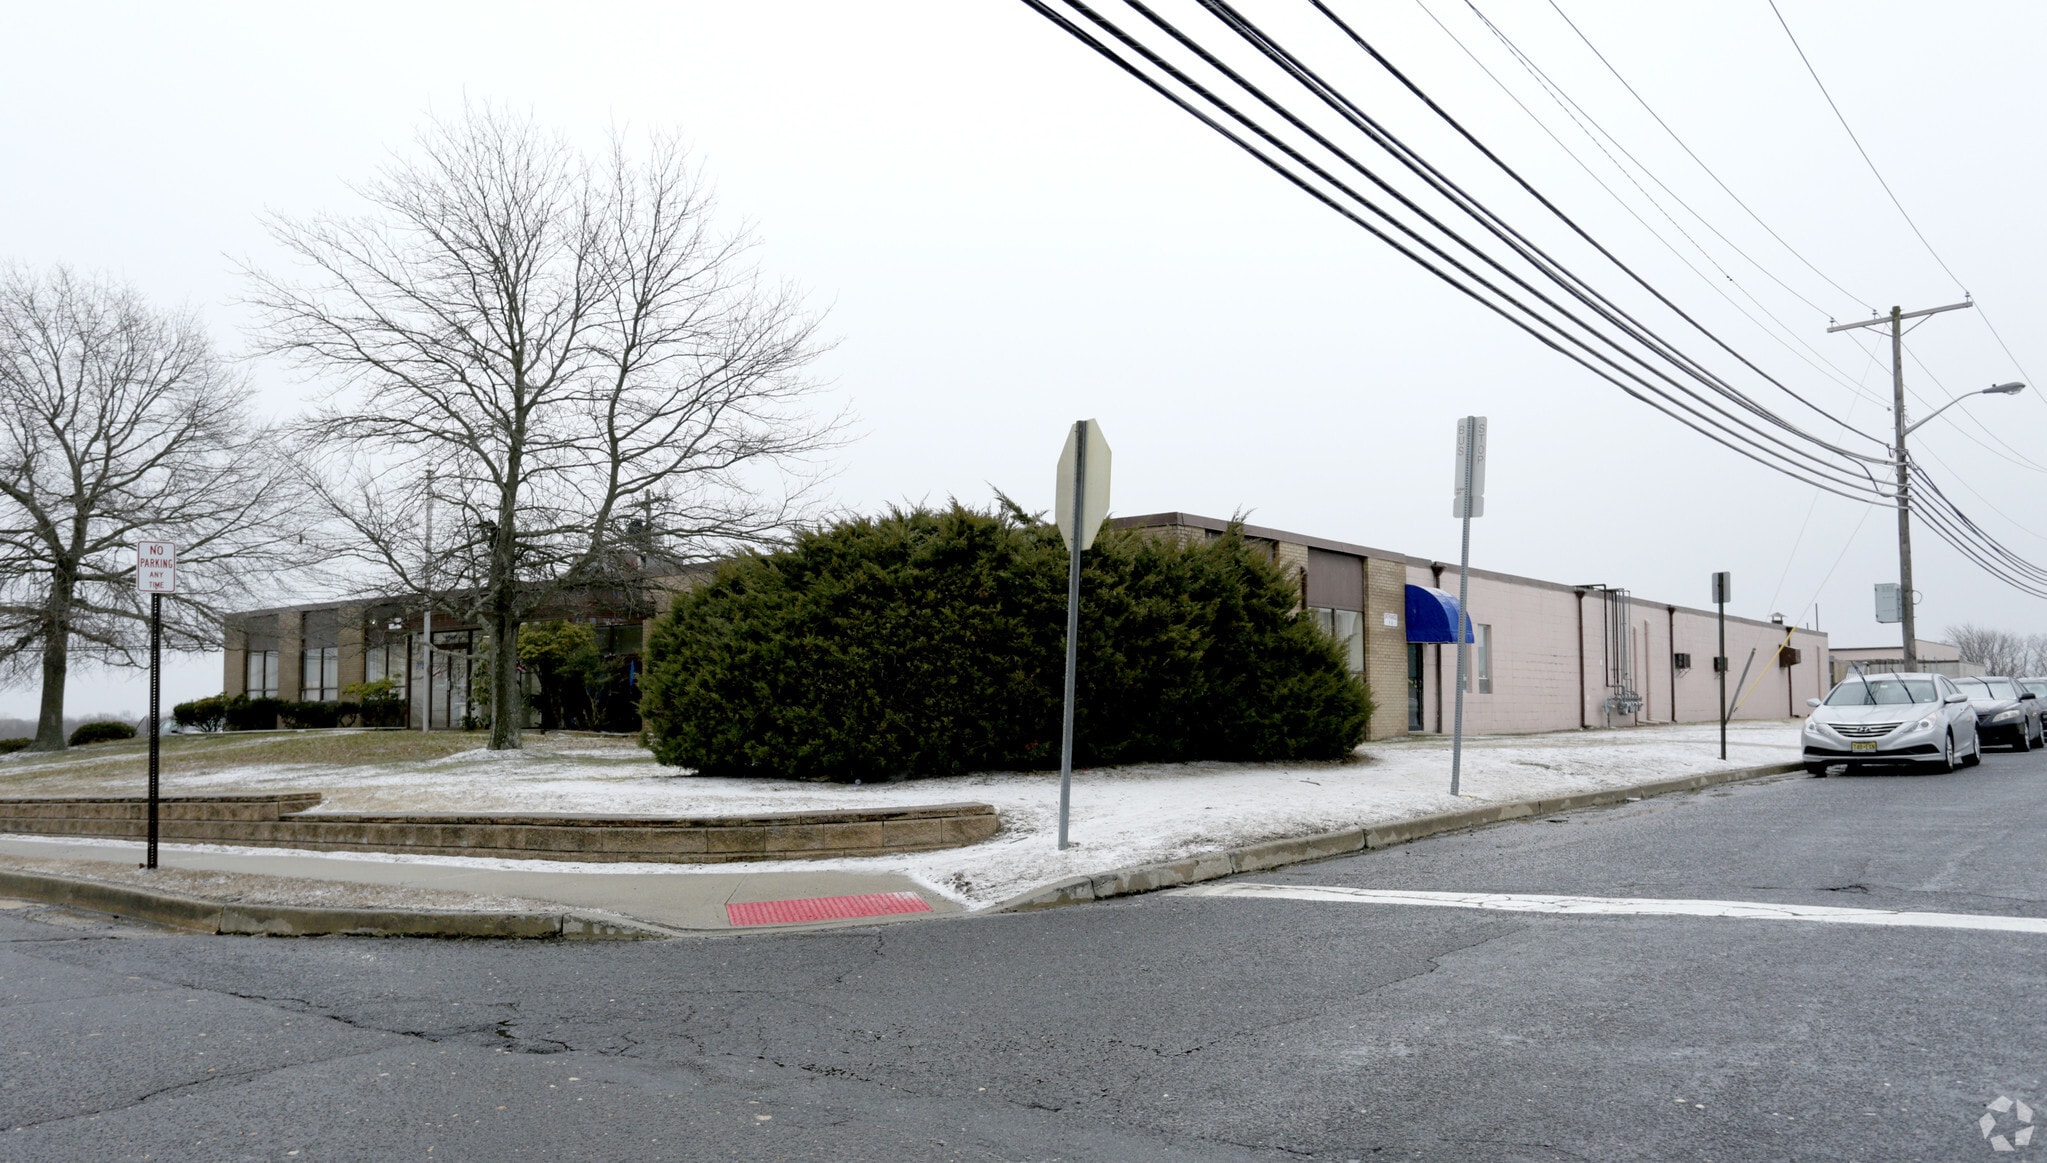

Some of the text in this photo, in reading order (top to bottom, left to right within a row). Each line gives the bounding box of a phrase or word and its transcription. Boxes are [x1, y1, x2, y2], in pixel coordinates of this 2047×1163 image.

[1457, 425, 1465, 456] BUS
[1477, 423, 1485, 465] STOP
[150, 545, 164, 555] NO
[140, 558, 173, 569] PARKING
[149, 581, 164, 589] TIME
